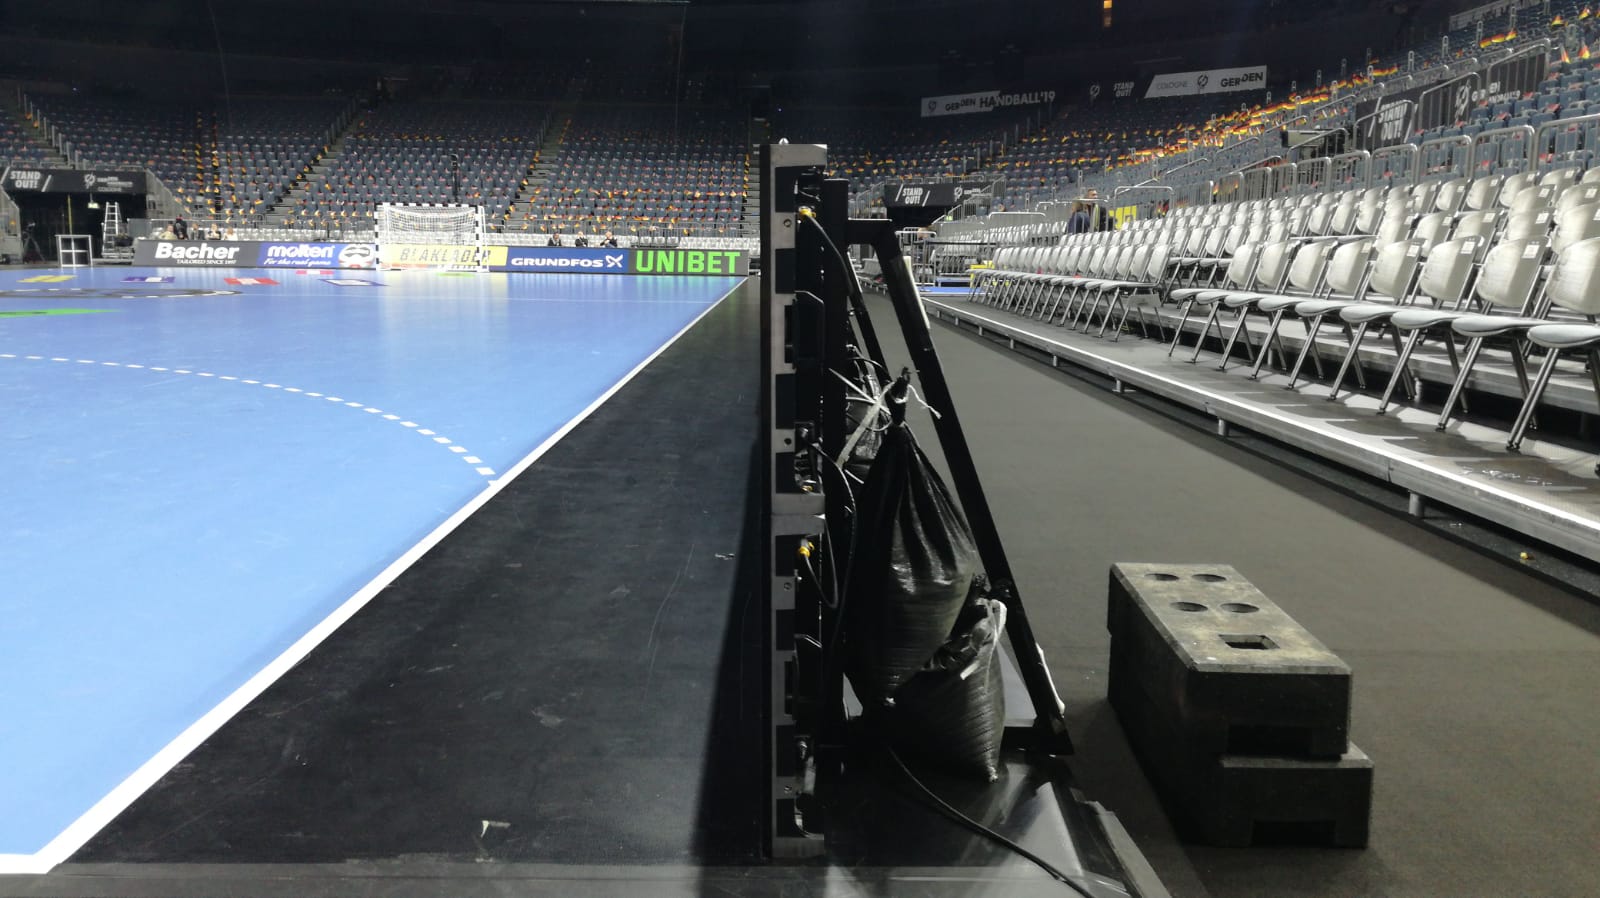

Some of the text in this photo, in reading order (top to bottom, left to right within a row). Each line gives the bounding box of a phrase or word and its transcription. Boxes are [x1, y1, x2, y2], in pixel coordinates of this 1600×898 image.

[10, 171, 41, 180] STAND
[15, 180, 38, 189] OUT!
[902, 187, 923, 196] STAND
[905, 195, 921, 204] OUT!
[154, 242, 240, 260] Bacher
[267, 244, 335, 258] molten
[511, 257, 604, 268] GRUNDFOS
[636, 250, 741, 274] UNIBET
